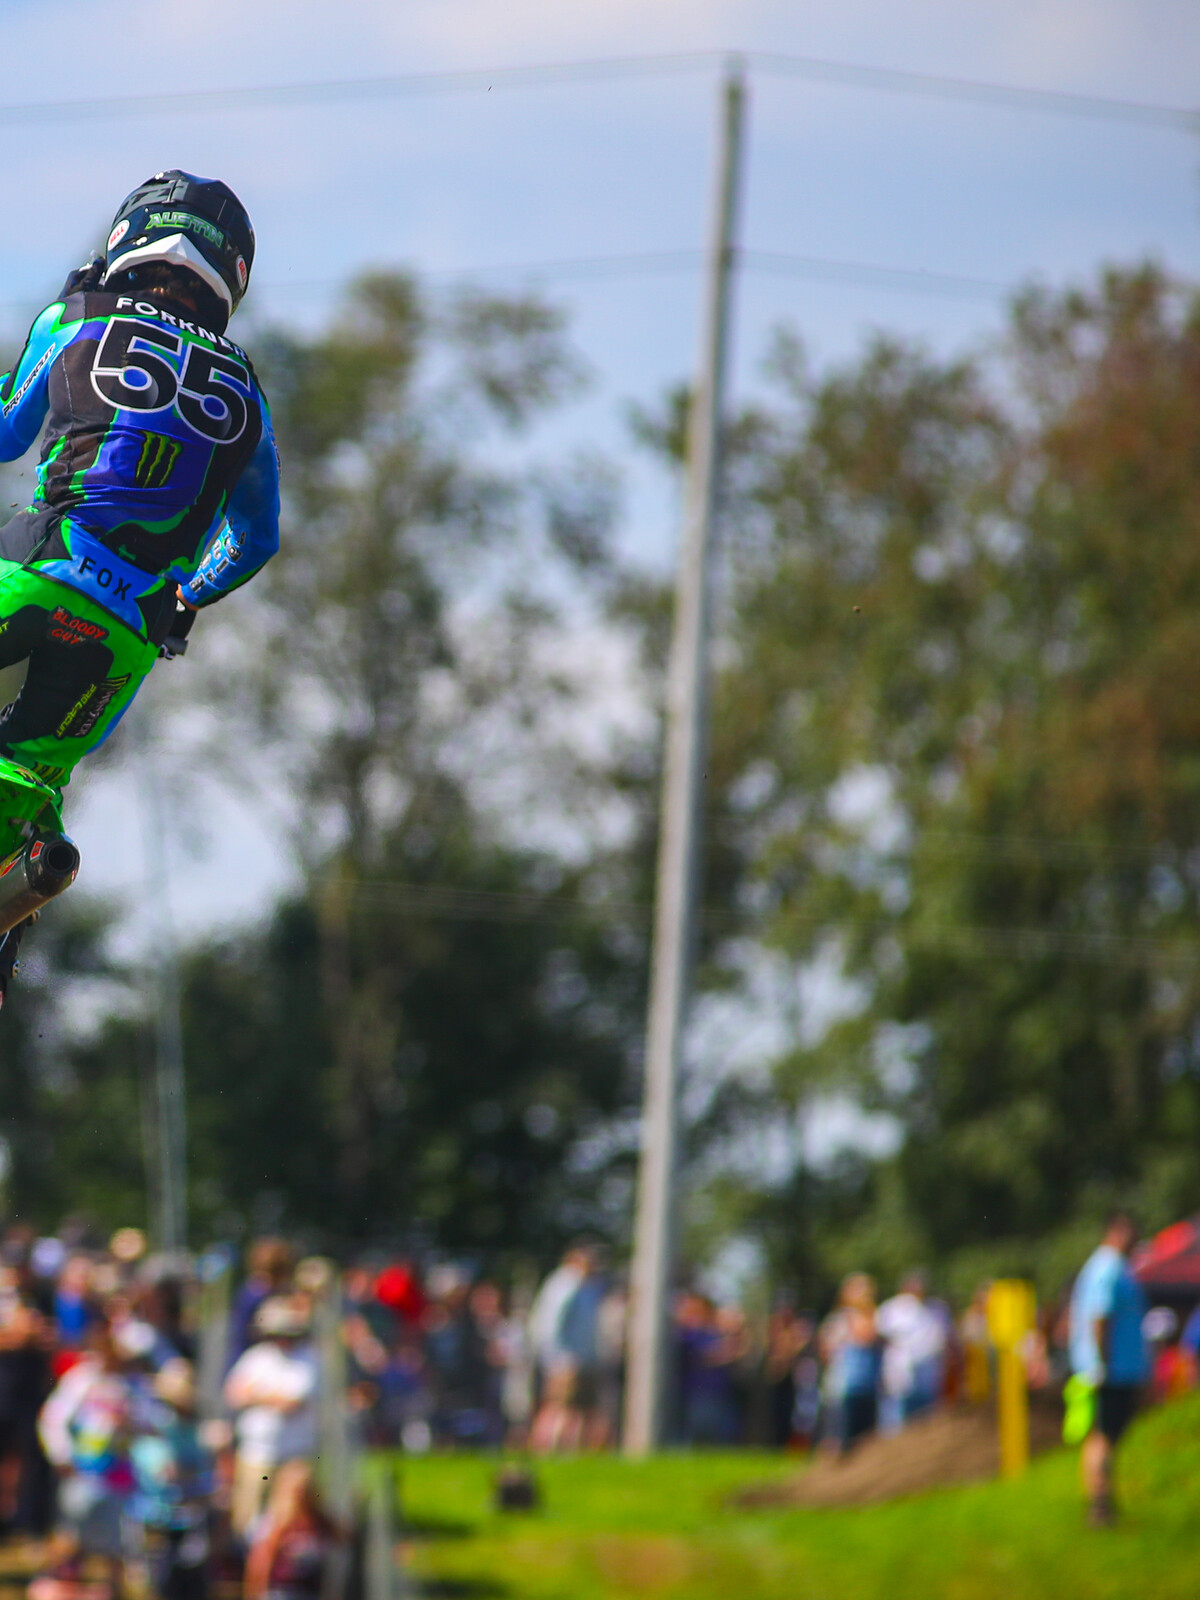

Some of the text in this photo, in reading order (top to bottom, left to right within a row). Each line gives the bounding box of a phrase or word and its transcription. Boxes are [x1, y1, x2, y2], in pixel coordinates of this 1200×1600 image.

[145, 211, 224, 248] AUSTIN
[115, 297, 247, 361] FORKNER
[90, 315, 251, 445] 55
[2, 387, 23, 418] PRO
[79, 556, 132, 602] FOX
[51, 628, 80, 644] GUY
[52, 611, 106, 639] BLOODY
[56, 683, 98, 738] PRO CIRCUIT
